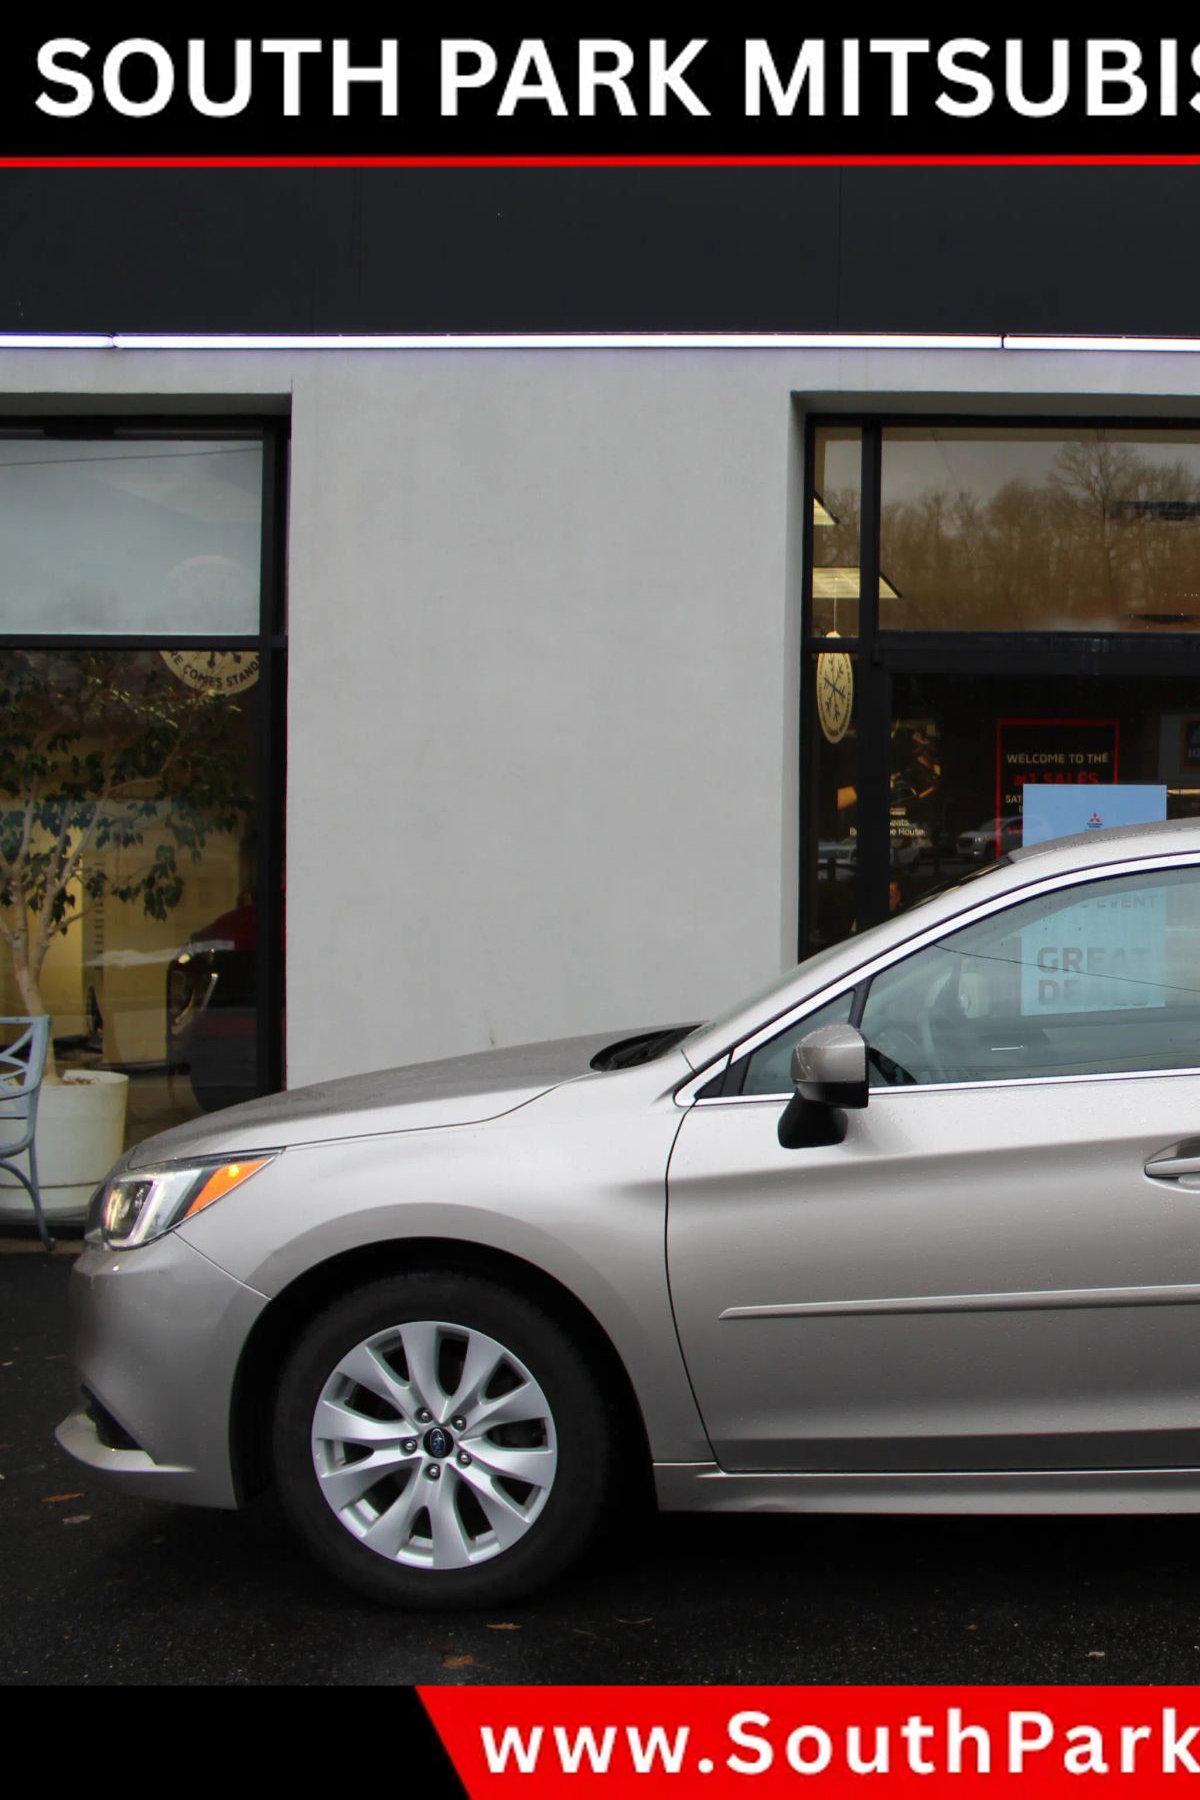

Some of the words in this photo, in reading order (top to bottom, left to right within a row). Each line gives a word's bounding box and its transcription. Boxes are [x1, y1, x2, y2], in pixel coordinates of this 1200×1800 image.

[183, 664, 223, 688] COMES
[225, 659, 259, 687] STAND
[1006, 753, 1065, 764] WELCOME
[1070, 753, 1084, 764] TO
[1087, 752, 1109, 764] THE
[1044, 771, 1099, 785] SALES
[1036, 946, 1152, 974] GREAT
